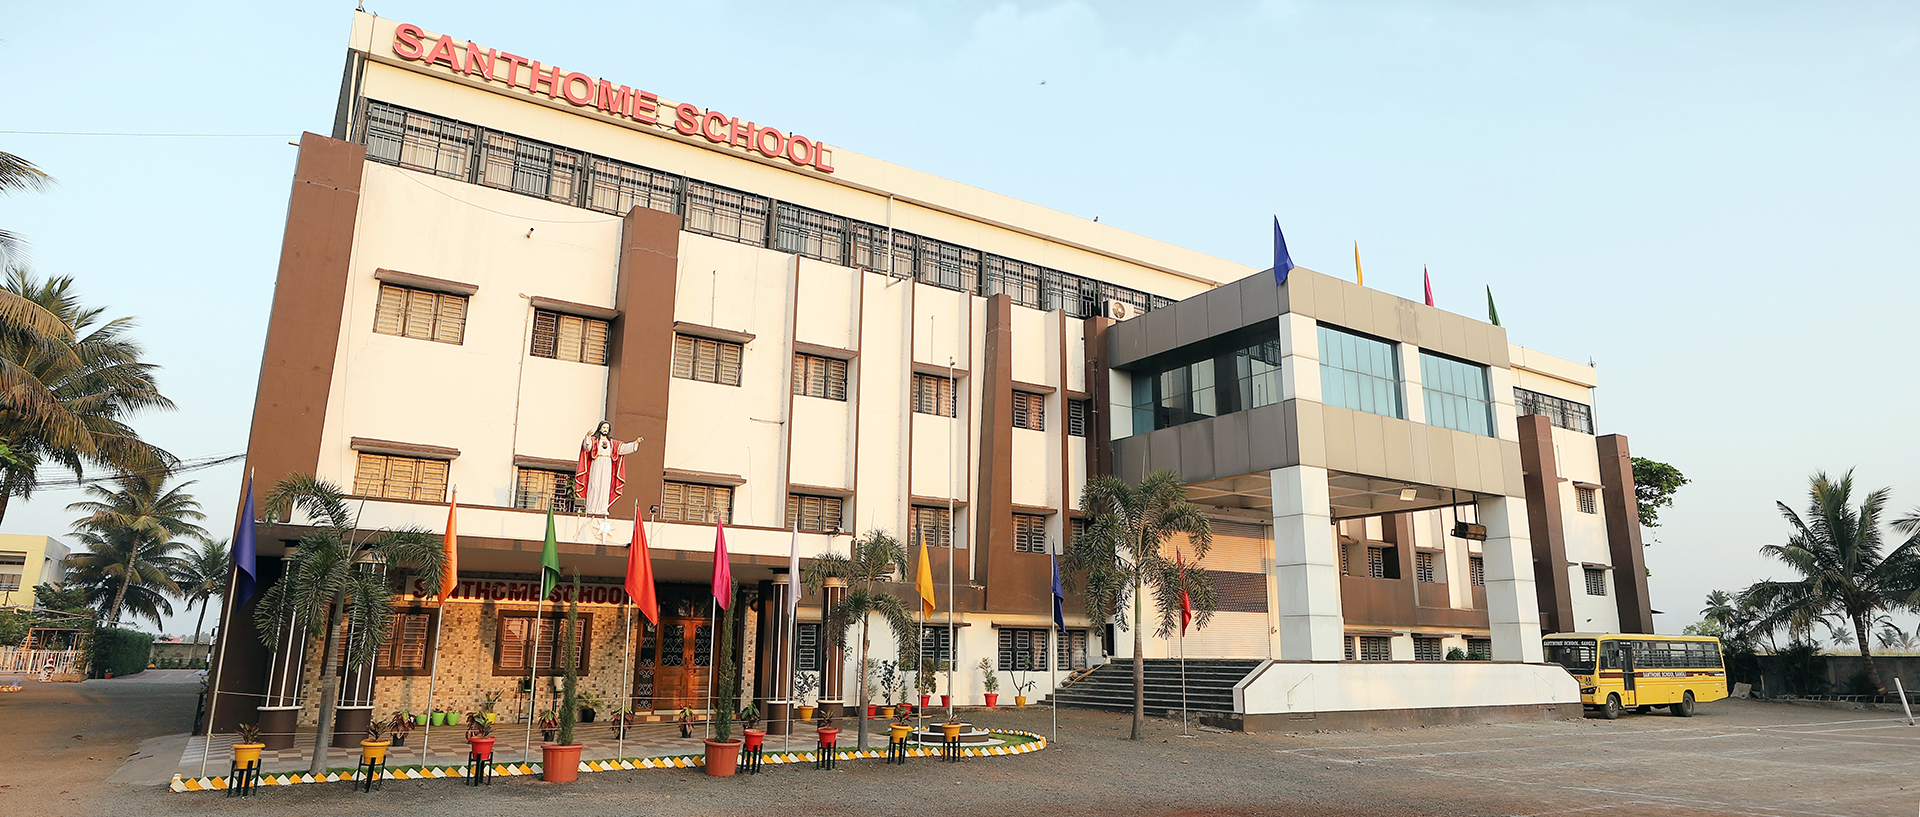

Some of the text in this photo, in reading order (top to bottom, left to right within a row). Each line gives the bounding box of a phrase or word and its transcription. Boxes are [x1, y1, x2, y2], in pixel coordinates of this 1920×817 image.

[392, 22, 835, 174] SANTHOME SCHOOL
[412, 579, 541, 602] SNTHOME
